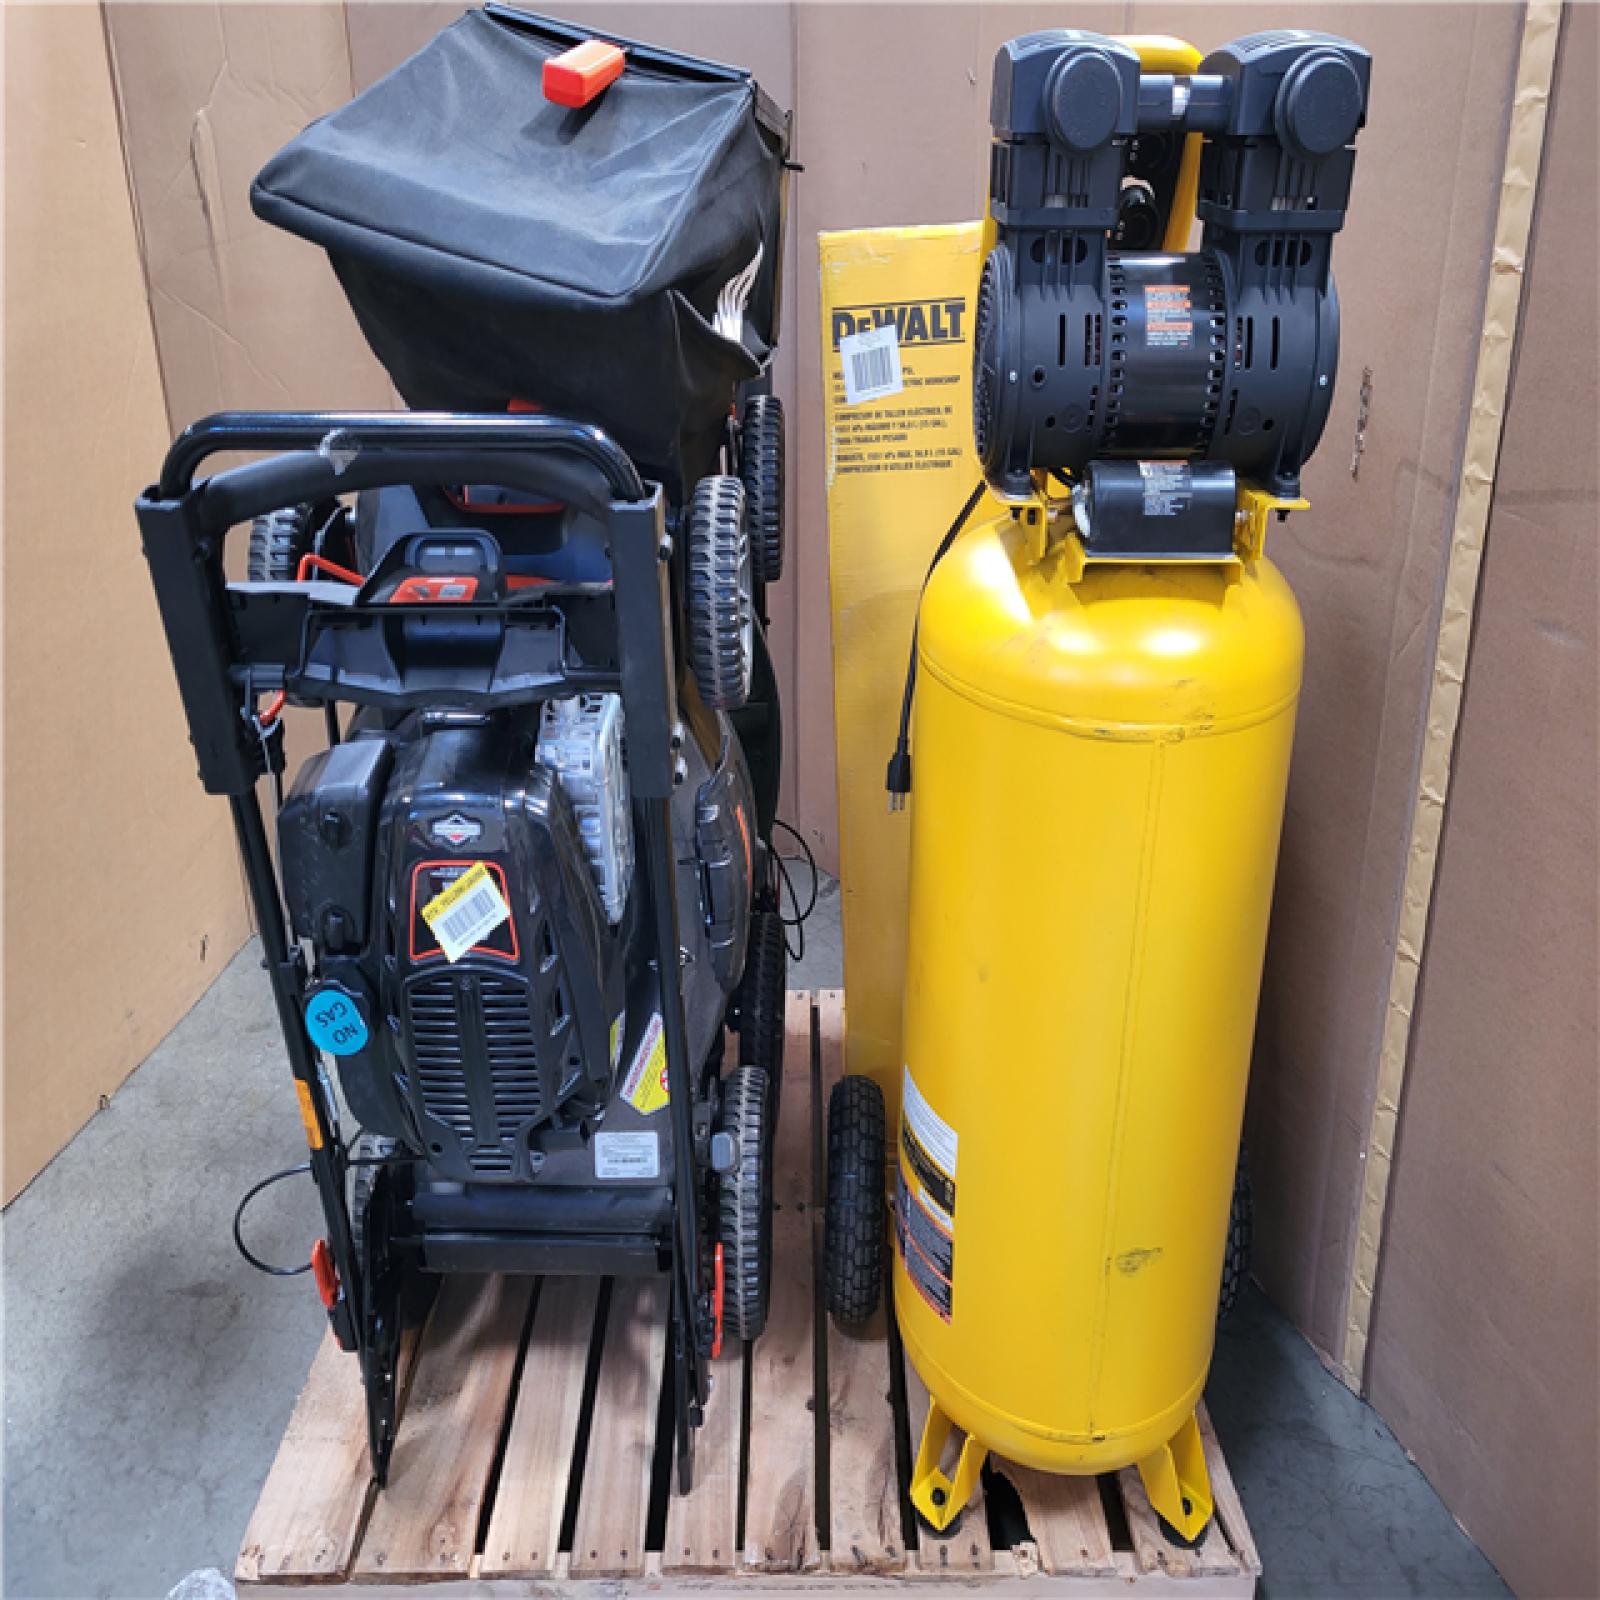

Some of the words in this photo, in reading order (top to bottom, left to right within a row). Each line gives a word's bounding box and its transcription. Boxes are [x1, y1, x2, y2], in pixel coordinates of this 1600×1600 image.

[832, 304, 966, 346] DEWALT
[314, 1001, 348, 1029] GAS
[332, 1023, 360, 1044] NO
